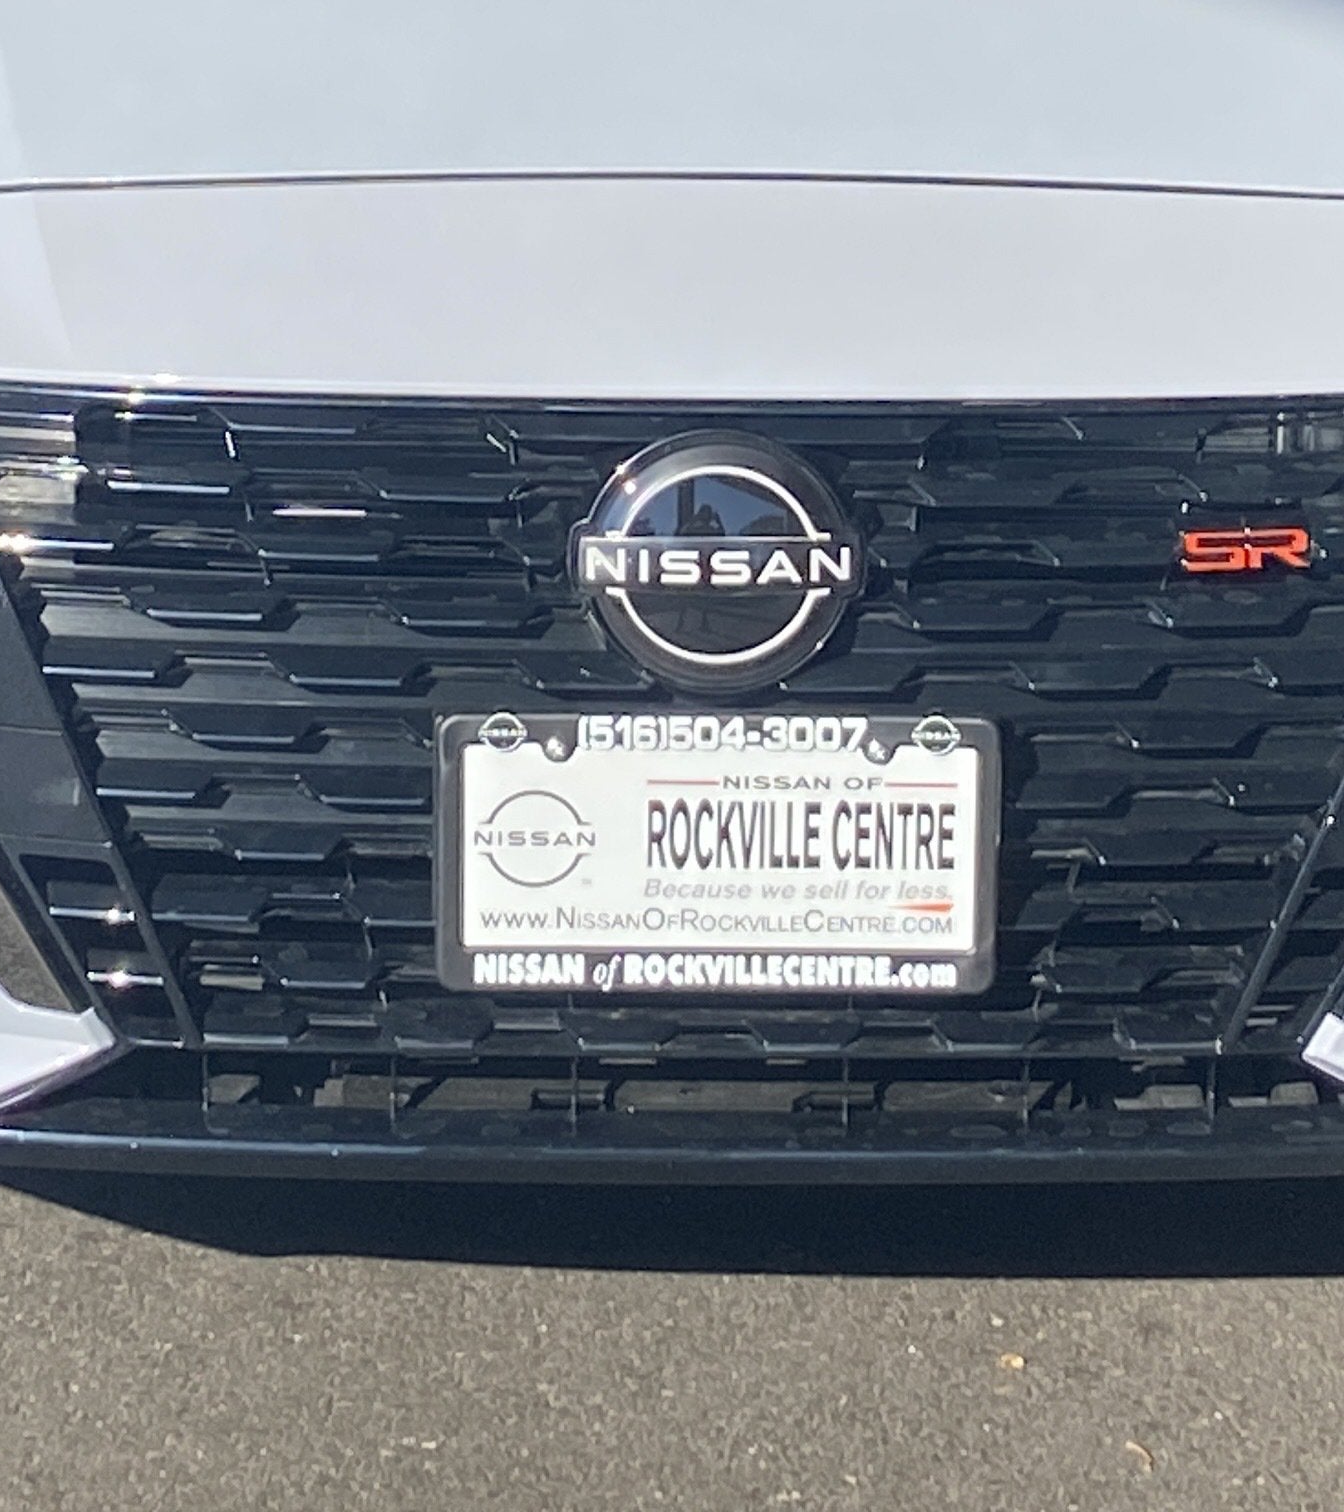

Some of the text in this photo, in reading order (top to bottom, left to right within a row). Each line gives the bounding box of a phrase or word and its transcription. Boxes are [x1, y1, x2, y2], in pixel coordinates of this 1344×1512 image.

[583, 546, 852, 585] NISSAN
[1181, 526, 1312, 573] SR
[578, 715, 868, 752] (516)504-3007
[722, 775, 884, 790] NISSAN OF
[473, 830, 596, 847] NISSAN
[646, 798, 956, 871] ROCKVILLE CENTRE
[642, 878, 953, 901] Because we sell for less.
[473, 952, 957, 992] NISSAN of ROCKVILLECENTRE.com
